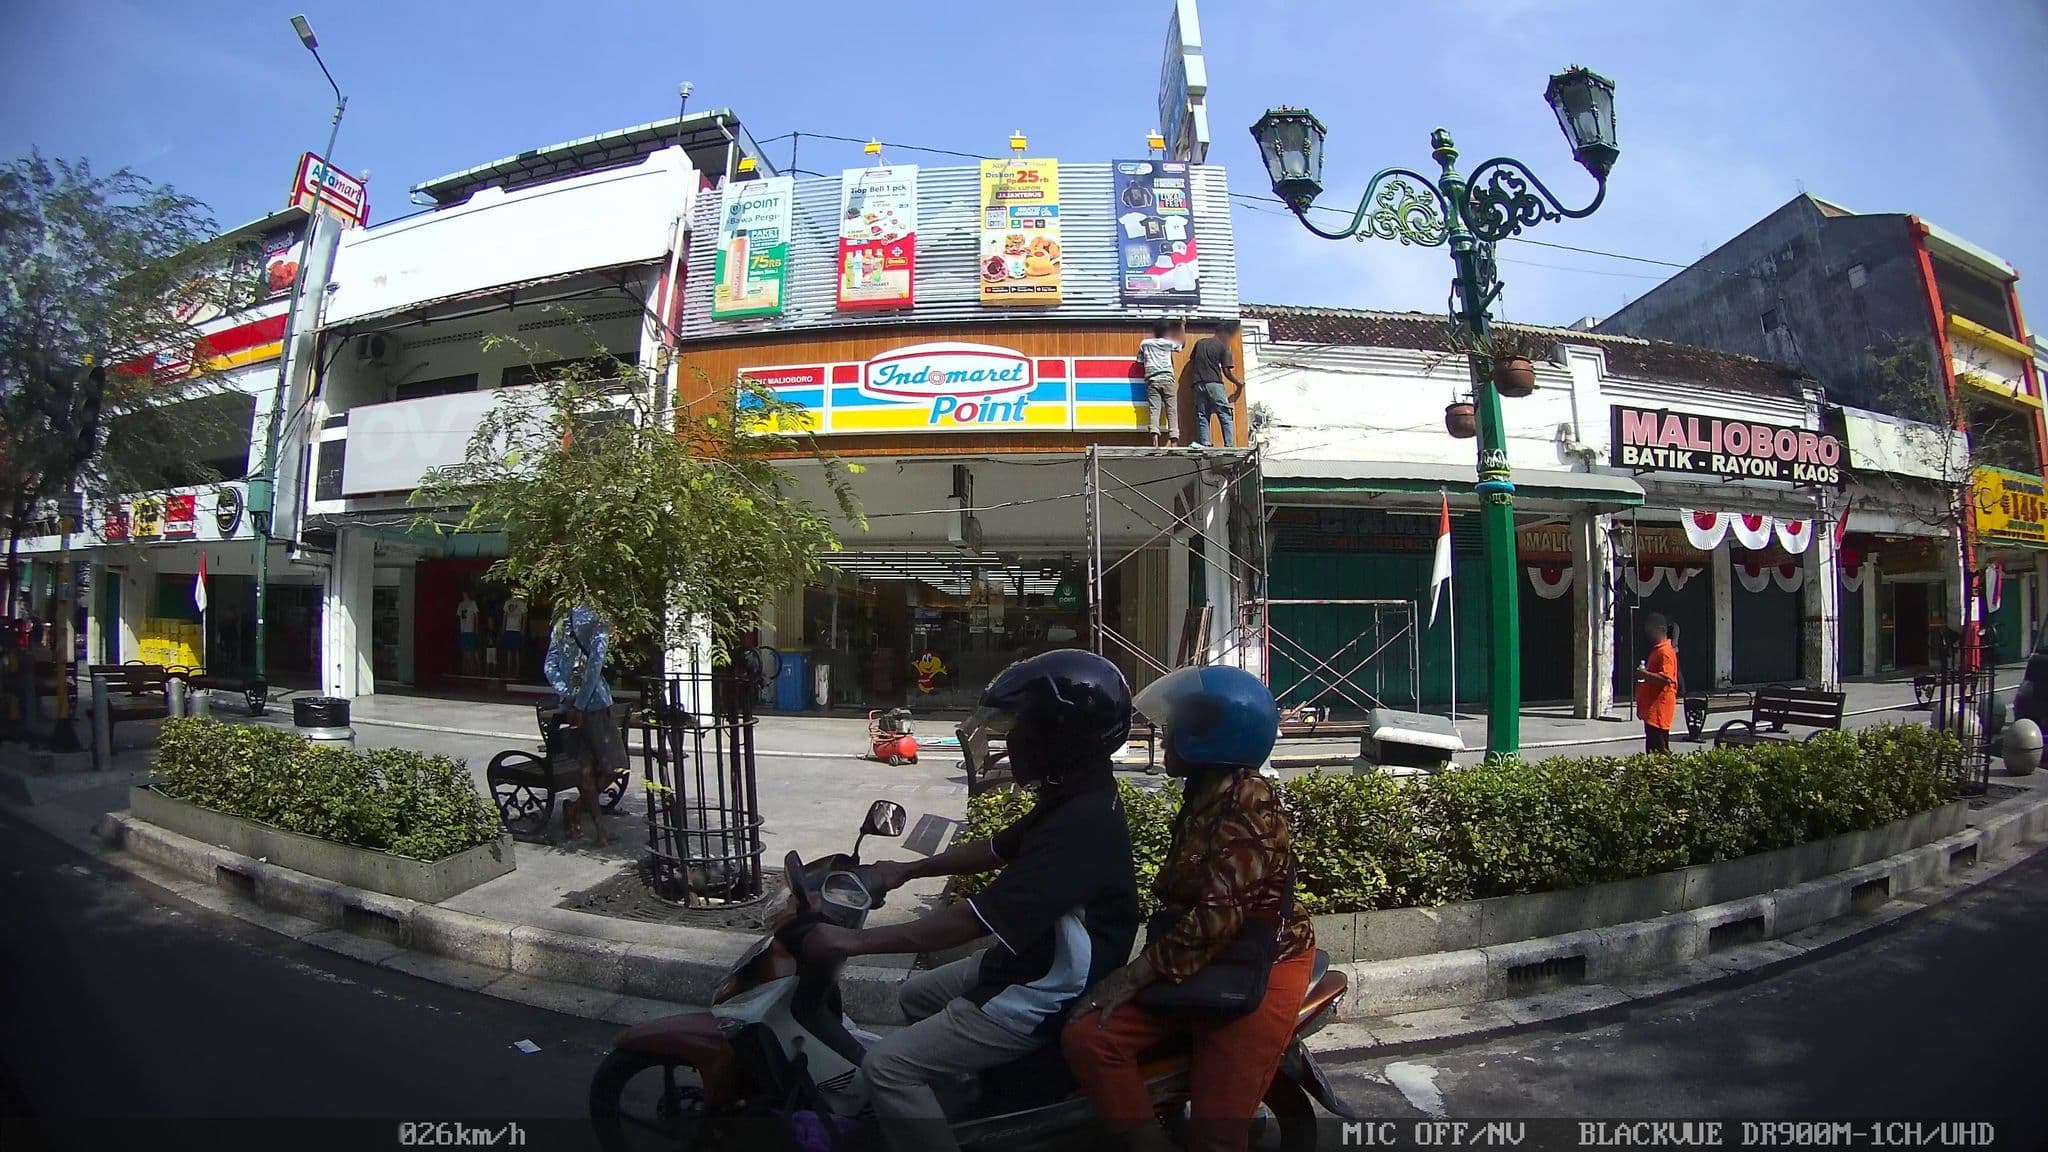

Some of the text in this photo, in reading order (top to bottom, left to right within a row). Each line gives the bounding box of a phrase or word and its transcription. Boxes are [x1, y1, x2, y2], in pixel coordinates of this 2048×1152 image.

[312, 164, 361, 201] Afamart
[767, 376, 814, 385] MALIOBORO
[873, 362, 1024, 386] Indomaret
[929, 394, 1030, 424] Point
[1622, 410, 1840, 466] MALIOBORO
[1623, 446, 1693, 470] BATIK
[1711, 455, 1778, 477] RAYON
[1793, 463, 1839, 484] KAOS
